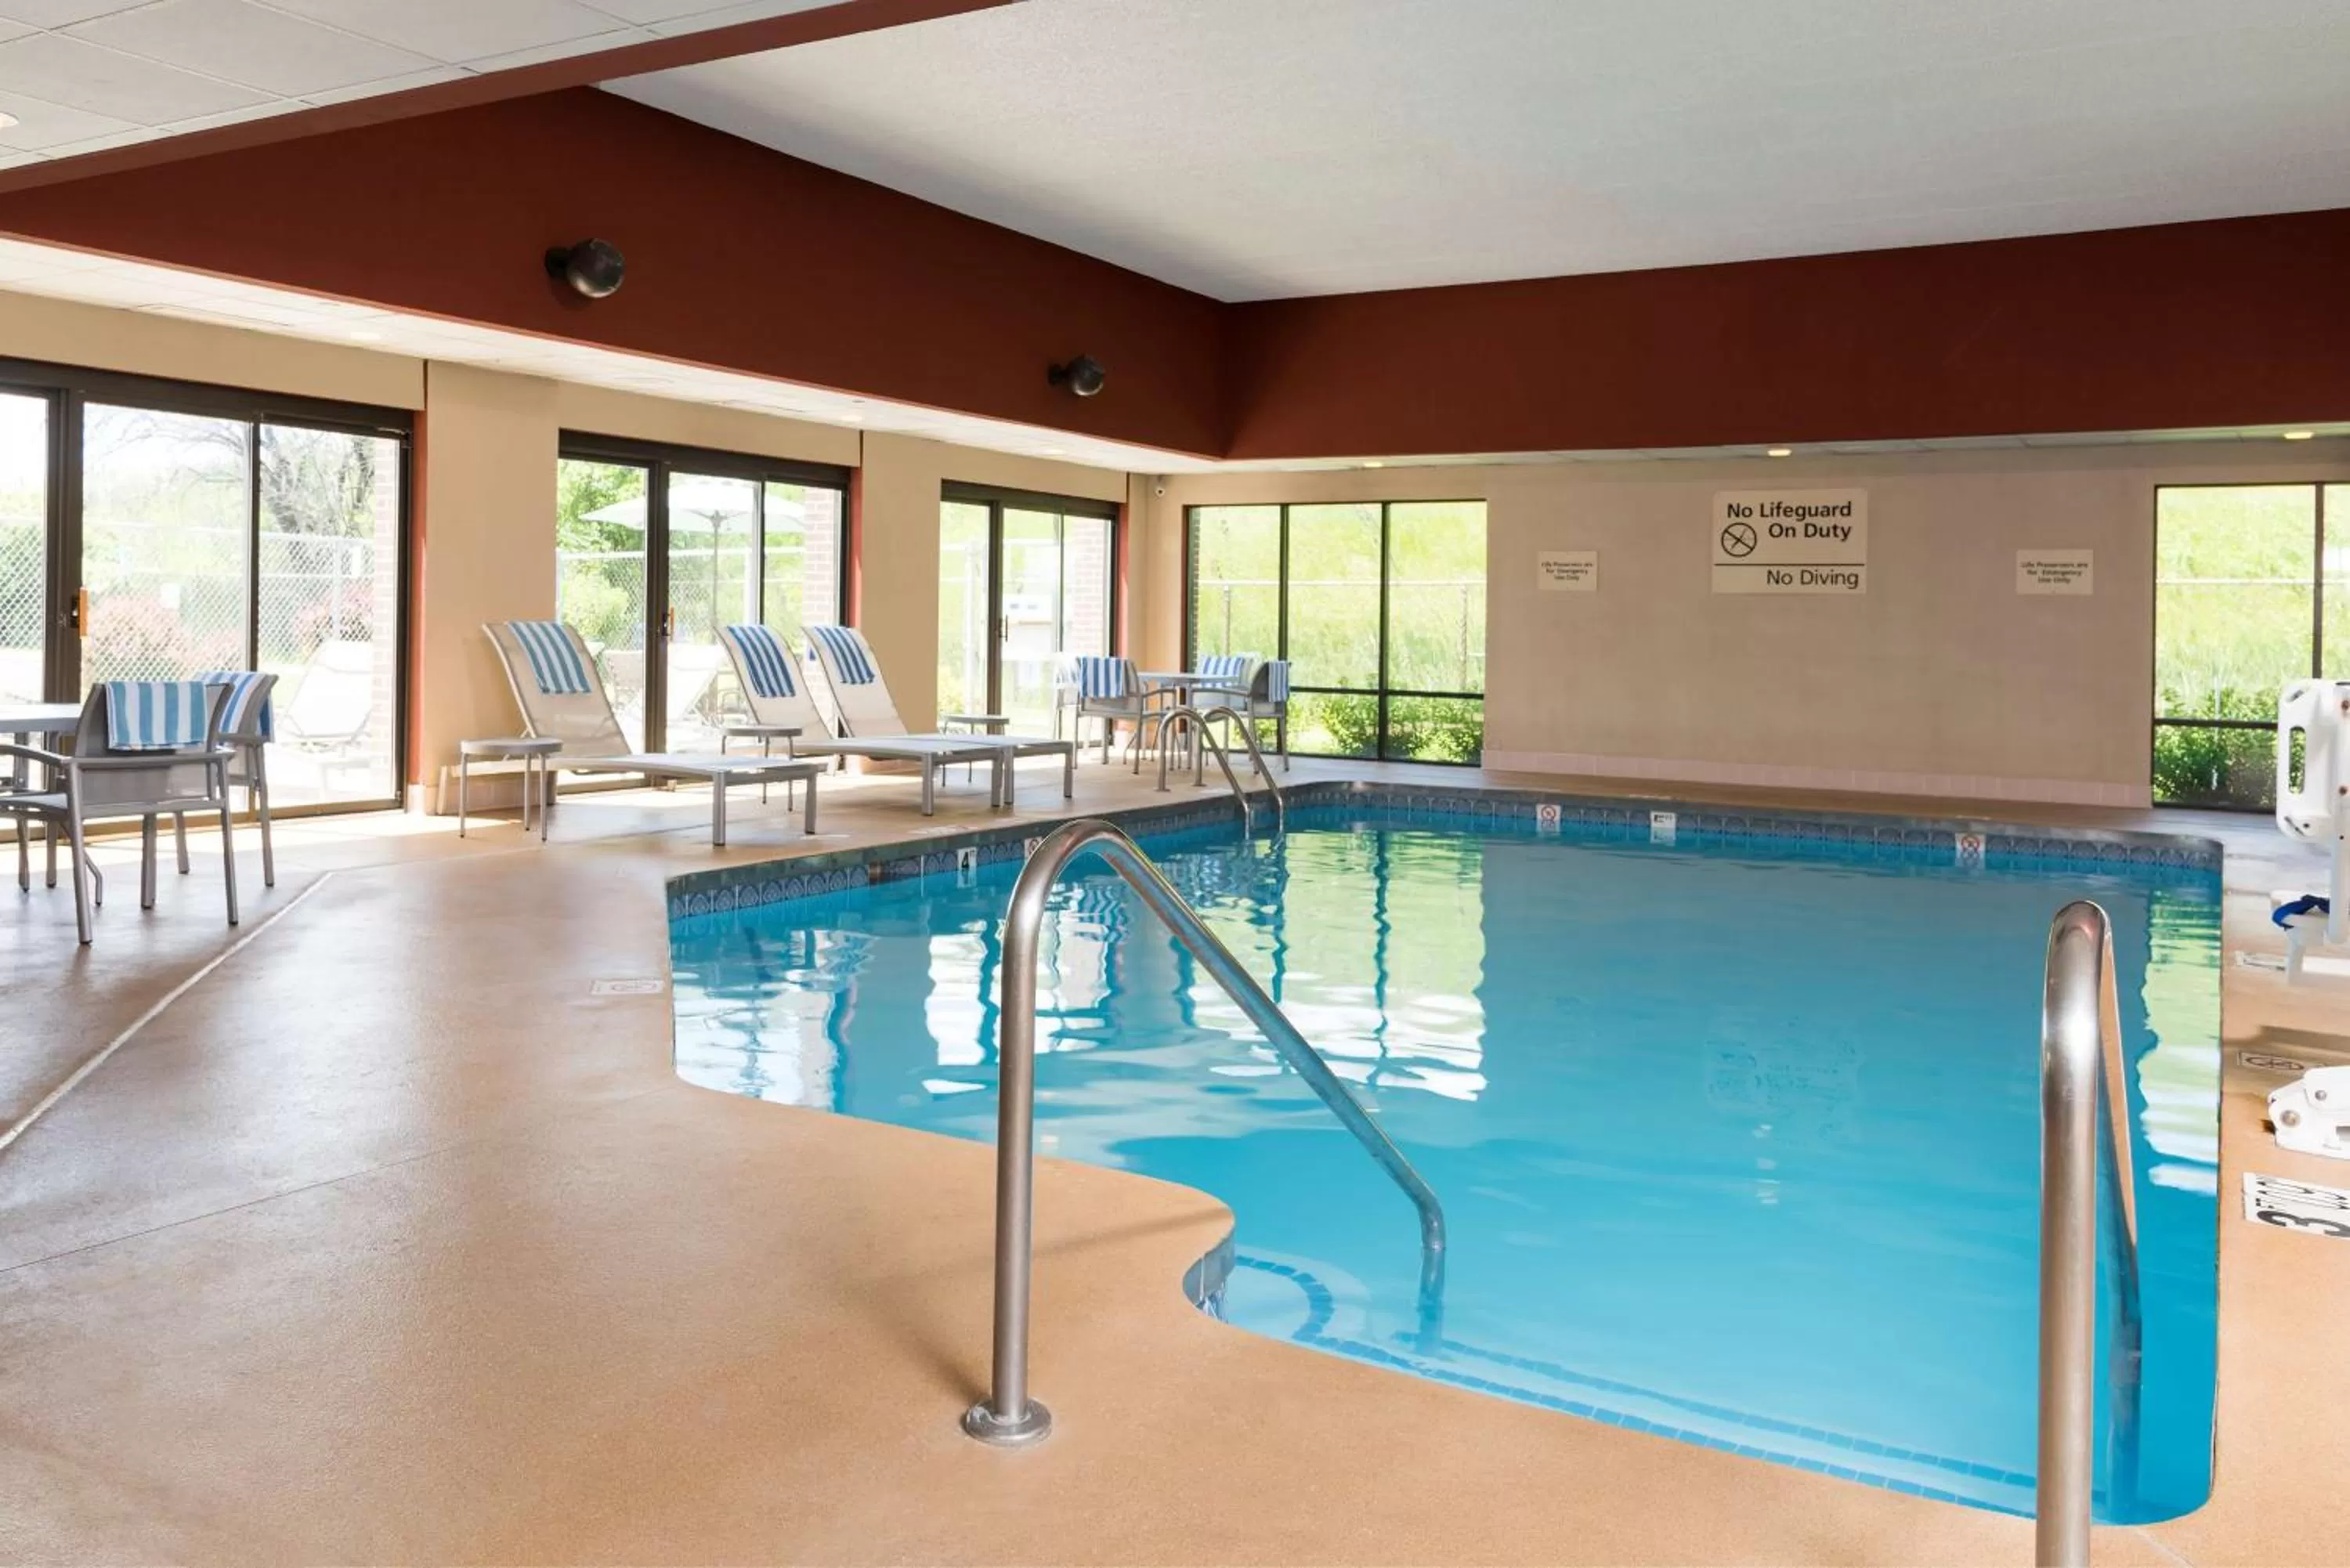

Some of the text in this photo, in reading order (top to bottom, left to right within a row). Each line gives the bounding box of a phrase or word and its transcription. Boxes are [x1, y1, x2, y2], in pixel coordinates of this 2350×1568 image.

[1727, 501, 1852, 521] No Lifeguard
[1769, 522, 1851, 541] On Duty
[1766, 569, 1859, 589] No Diving
